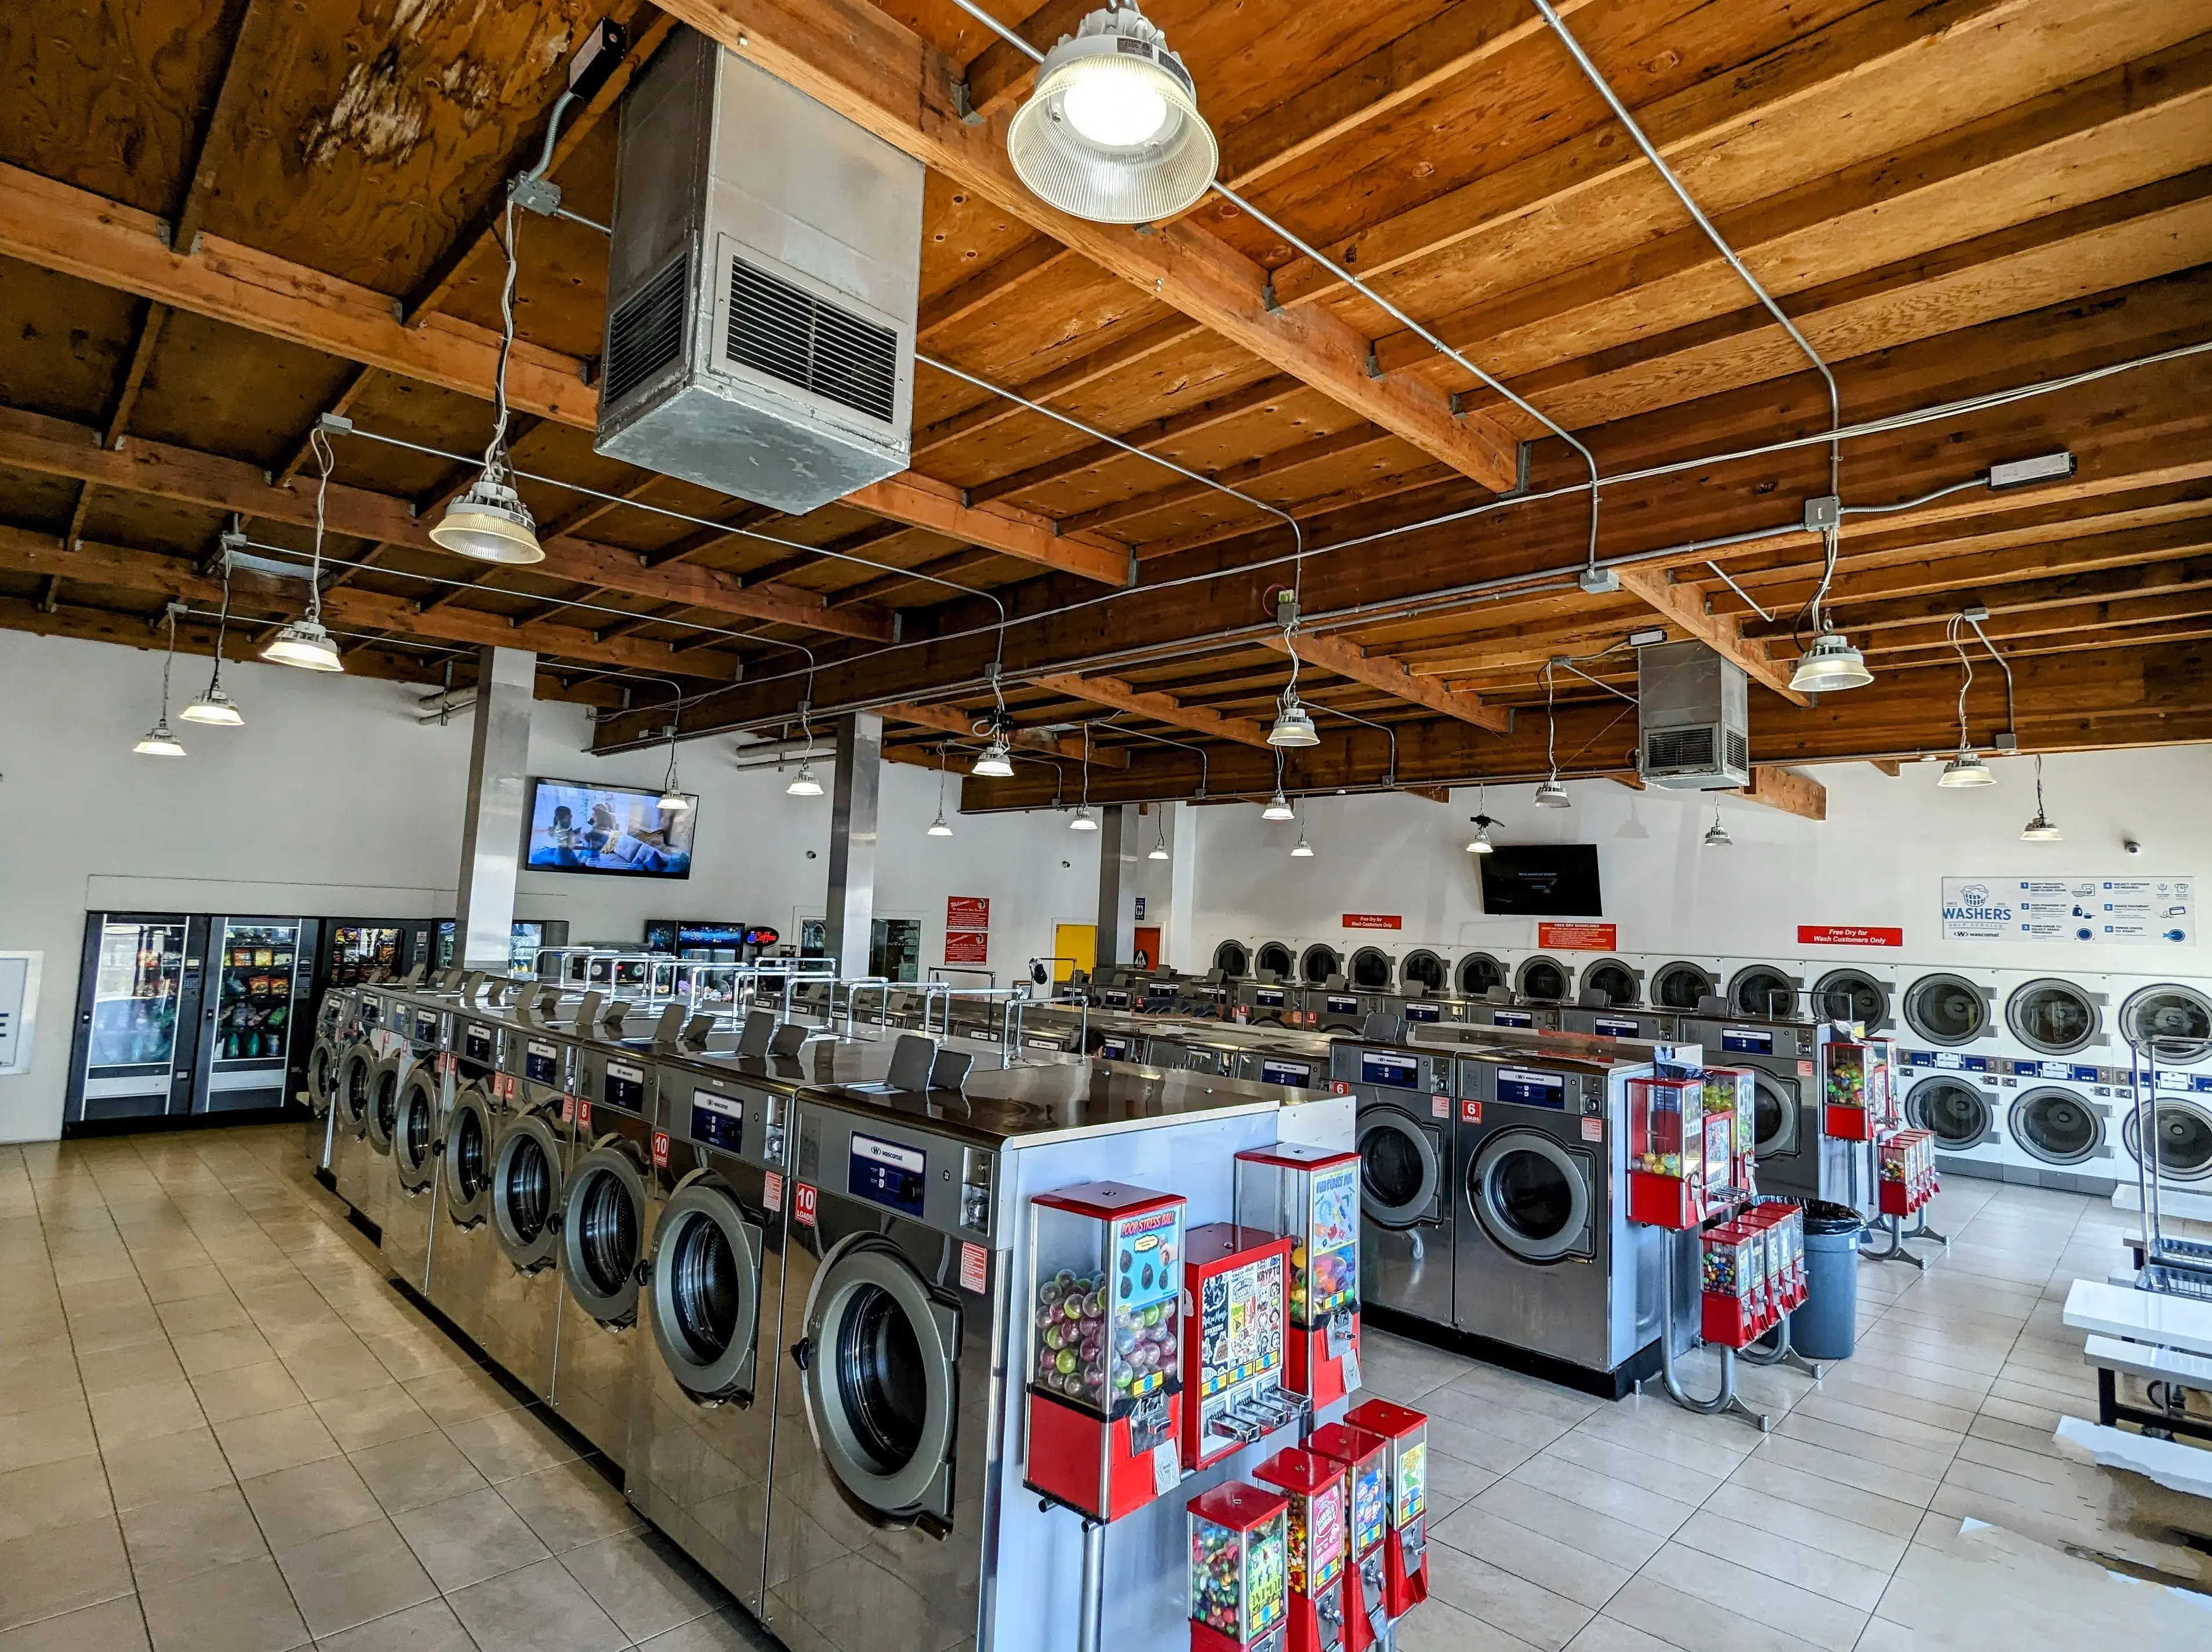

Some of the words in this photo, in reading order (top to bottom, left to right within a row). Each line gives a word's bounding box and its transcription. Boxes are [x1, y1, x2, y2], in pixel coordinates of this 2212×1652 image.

[1942, 908, 2012, 920] WASHERS
[755, 931, 777, 943] Coffee
[1832, 936, 1869, 944] Customers
[1869, 937, 1887, 945] Only
[507, 1079, 512, 1091] 8
[1336, 1083, 1344, 1094] 6
[582, 1103, 587, 1118] 8
[1467, 1102, 1476, 1115] 6
[656, 1136, 667, 1155] 10
[881, 1150, 903, 1162] wascomat
[798, 1187, 814, 1210] 10
[797, 1209, 813, 1222] LOADS
[1120, 1219, 1139, 1239] POOP
[1138, 1214, 1161, 1233] STRESS
[1161, 1210, 1175, 1228] BALL
[1232, 1271, 1244, 1279] TACO
[1257, 1265, 1280, 1283] KRYPTO
[1204, 1323, 1224, 1337] STICKERS
[1317, 1505, 1336, 1527] DUBBLE
[1250, 1577, 1282, 1607] ANIMAL
